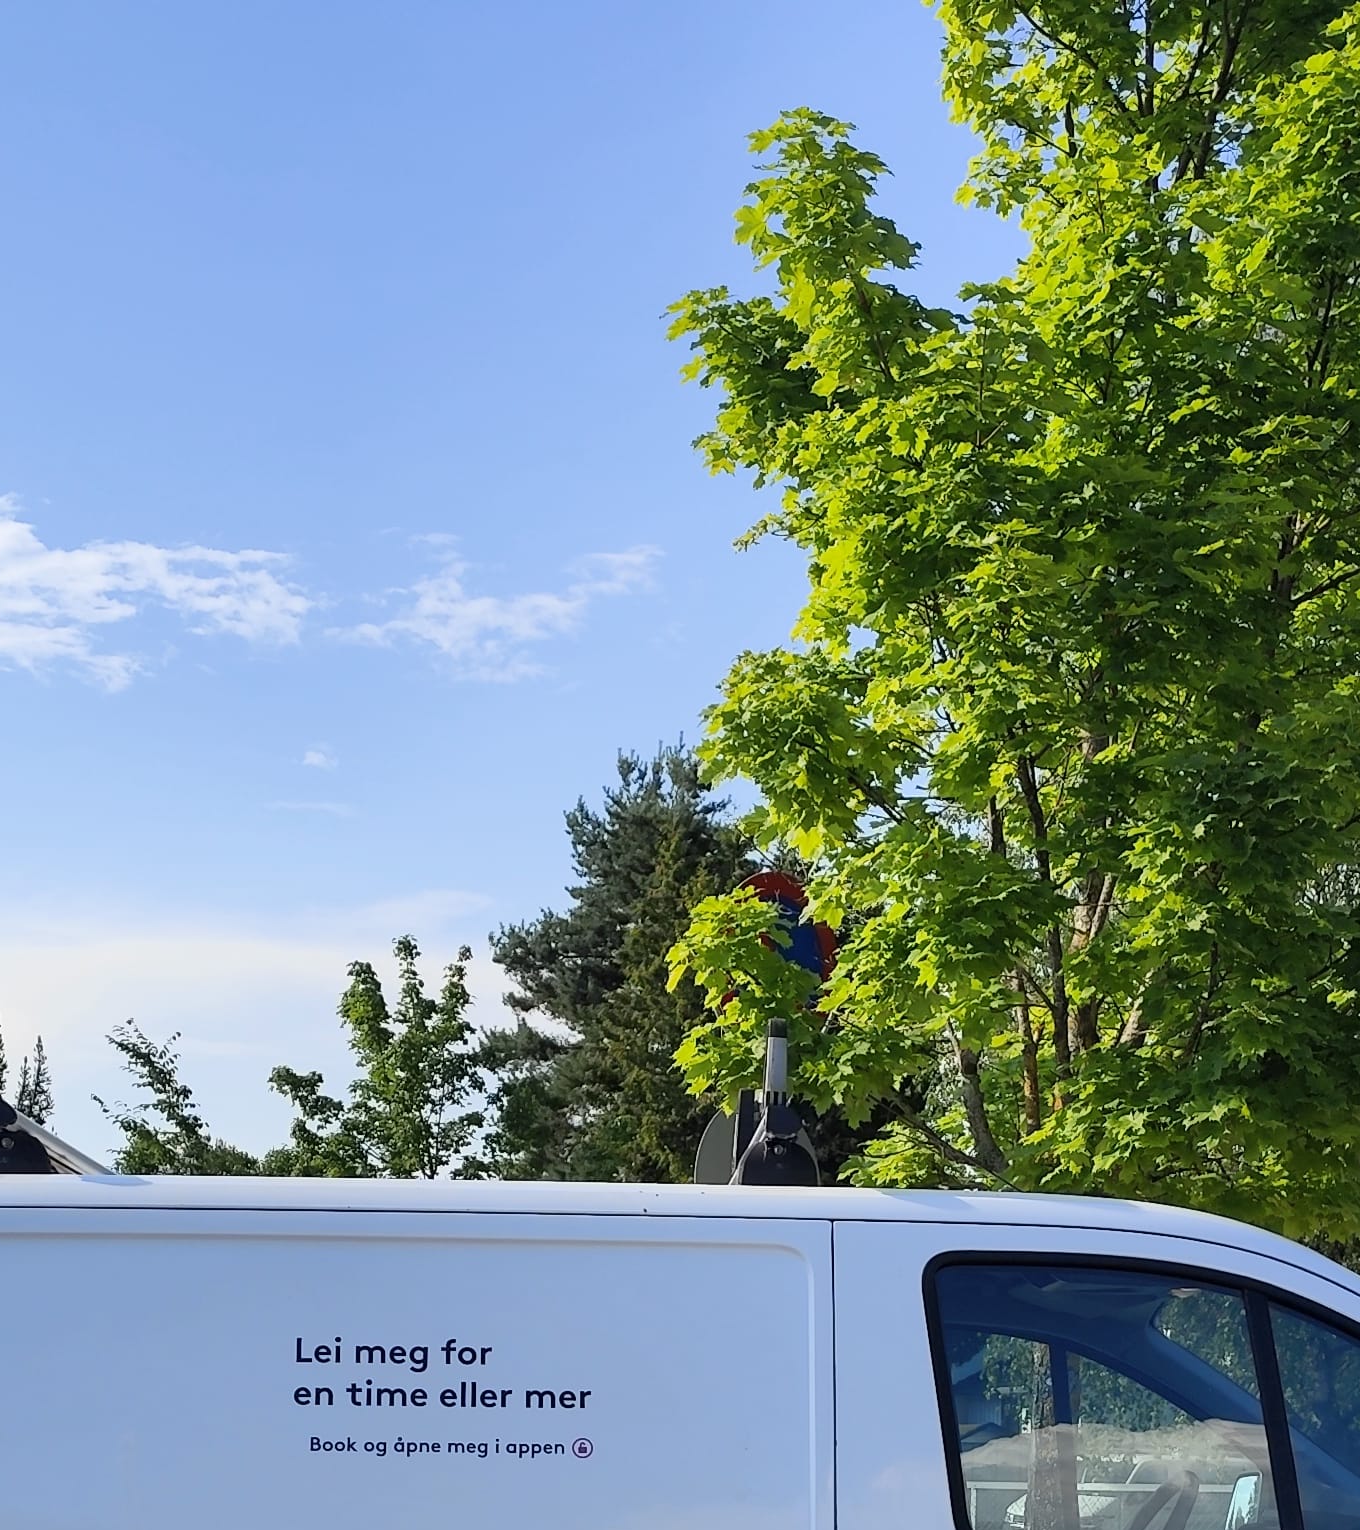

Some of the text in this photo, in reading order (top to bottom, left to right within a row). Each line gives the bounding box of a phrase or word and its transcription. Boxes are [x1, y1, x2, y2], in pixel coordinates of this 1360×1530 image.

[295, 1336, 493, 1373] Lei meg for
[293, 1379, 592, 1409] en time eller mer
[309, 1436, 565, 1459] Book og åpne meg i appen
